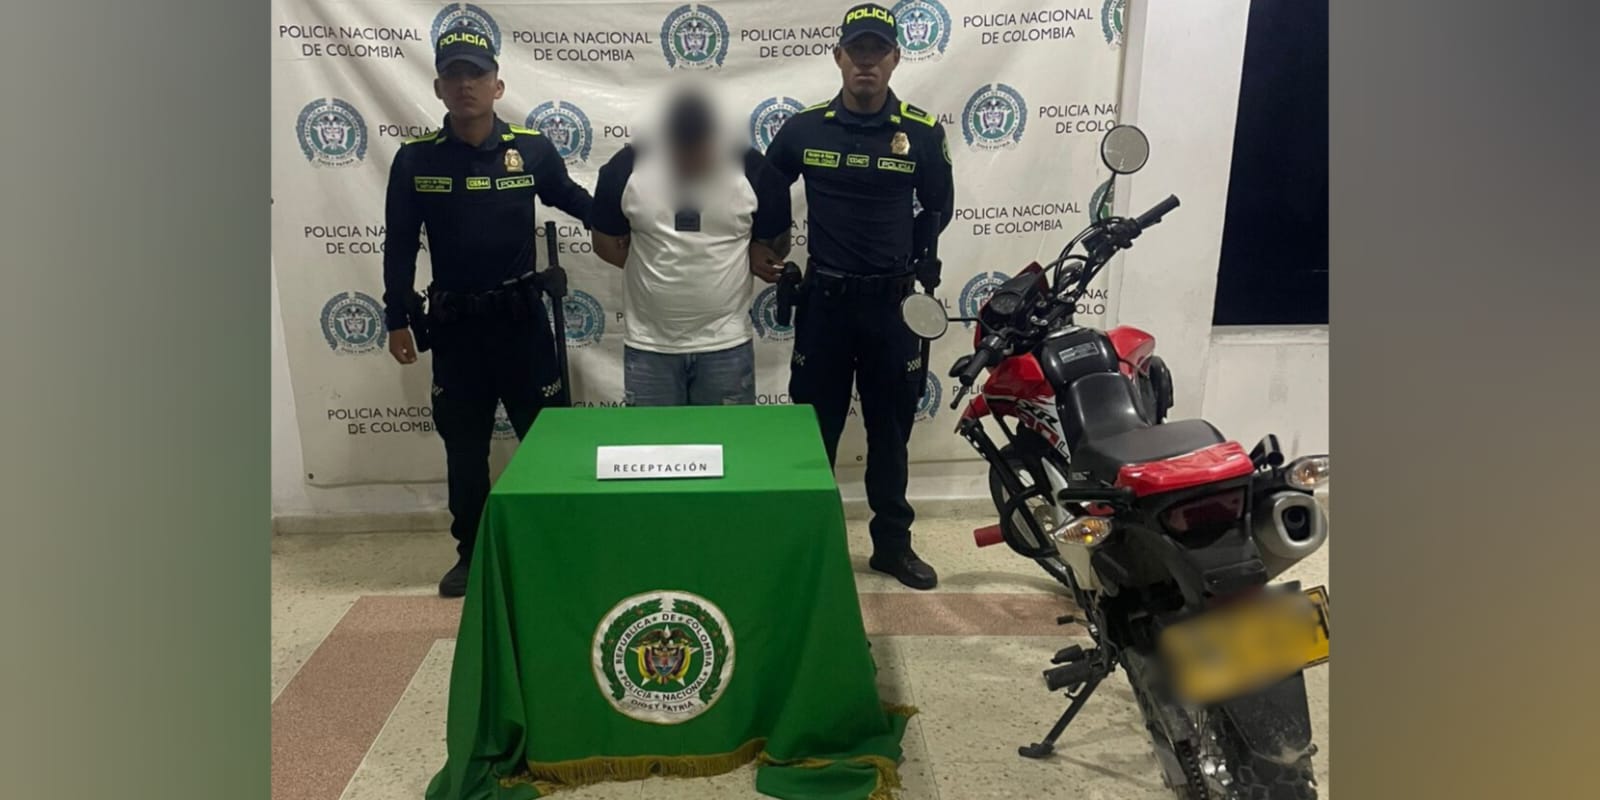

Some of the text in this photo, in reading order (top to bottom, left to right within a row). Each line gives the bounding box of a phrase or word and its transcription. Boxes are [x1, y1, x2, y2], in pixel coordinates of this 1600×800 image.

[963, 8, 1093, 28] POLICIA NACIONAL
[279, 25, 422, 41] POLICIA NACIONAL
[513, 31, 652, 44] POLICIA NACIONAL
[741, 28, 796, 41] POLICIA
[981, 27, 1076, 45] DE COLOMBIA
[302, 43, 405, 59] DE COLOMBIA
[534, 49, 634, 62] DE COLOMBIA
[759, 46, 778, 58] DE
[1039, 104, 1090, 118] POLICIA
[379, 124, 432, 138] POLICIA
[1055, 121, 1072, 134] DE
[955, 203, 1081, 221] POLICIA NACIONAL
[304, 226, 361, 238] POLICIA
[973, 219, 1063, 236] DE COLOMBIA
[326, 242, 345, 254] DE
[328, 407, 381, 420] POLICIA
[348, 423, 366, 435] DE
[613, 462, 708, 473] RECEPTACIÓN
[615, 613, 712, 667] REPUBLICA DE COLOMBIA
[620, 673, 708, 701] POLICIA NACIONAL
[662, 701, 694, 713] PATRIA
